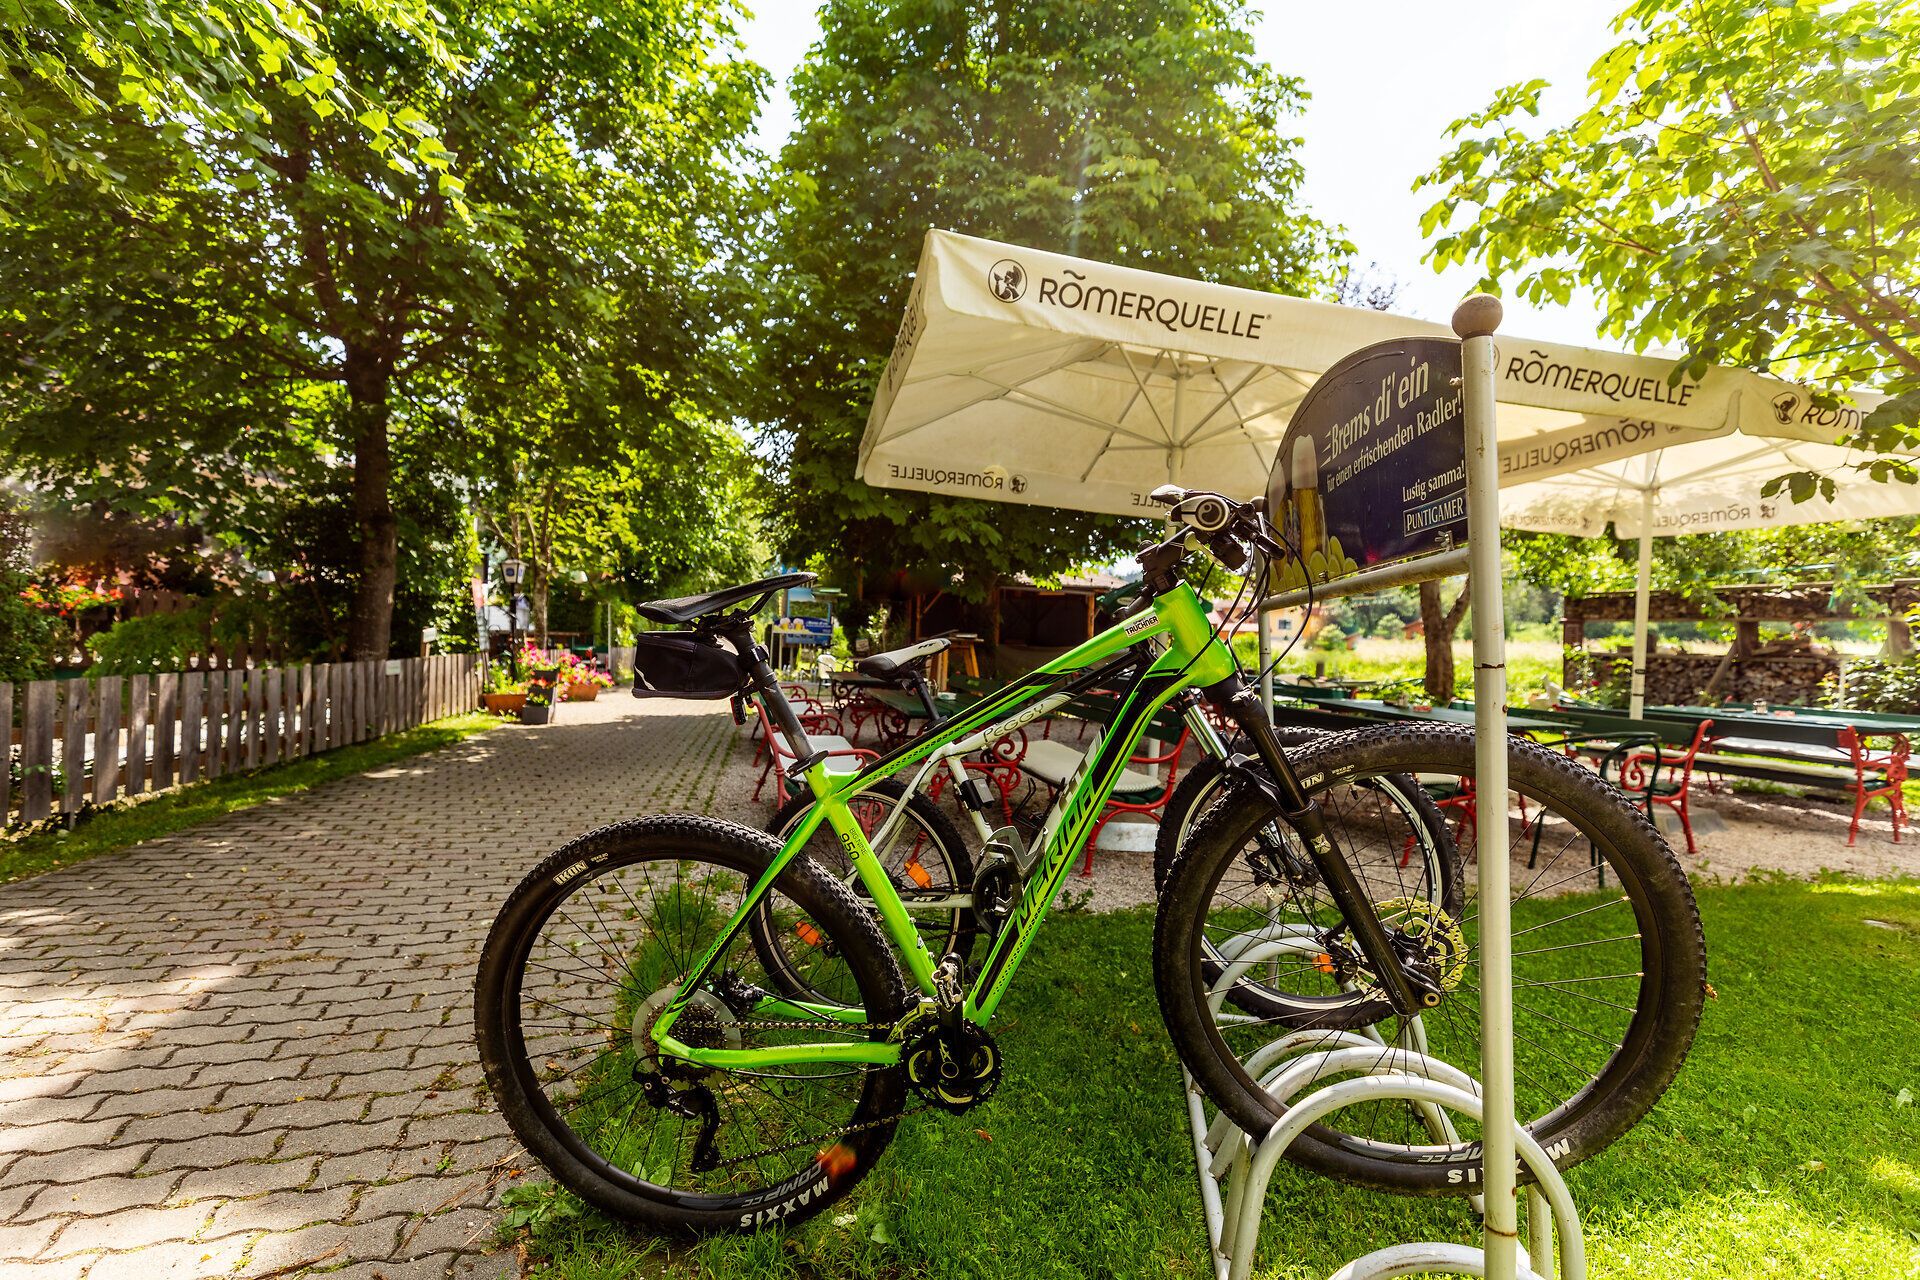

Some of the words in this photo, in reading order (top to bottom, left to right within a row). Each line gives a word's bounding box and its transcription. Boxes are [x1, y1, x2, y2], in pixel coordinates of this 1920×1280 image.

[1331, 405, 1371, 460] Brems
[1398, 355, 1429, 409] ein
[1336, 462, 1353, 488] einen
[1353, 422, 1414, 475] erfrischenden
[1416, 388, 1463, 437] Radler!
[1402, 479, 1427, 502] Lustig
[1428, 459, 1465, 492] samma!
[1406, 497, 1464, 532] PUNTIGAMER
[840, 832, 860, 861] 950
[1014, 777, 1096, 935] MERIDA
[554, 860, 588, 885] IKON
[740, 1175, 829, 1228] MAXXIS
